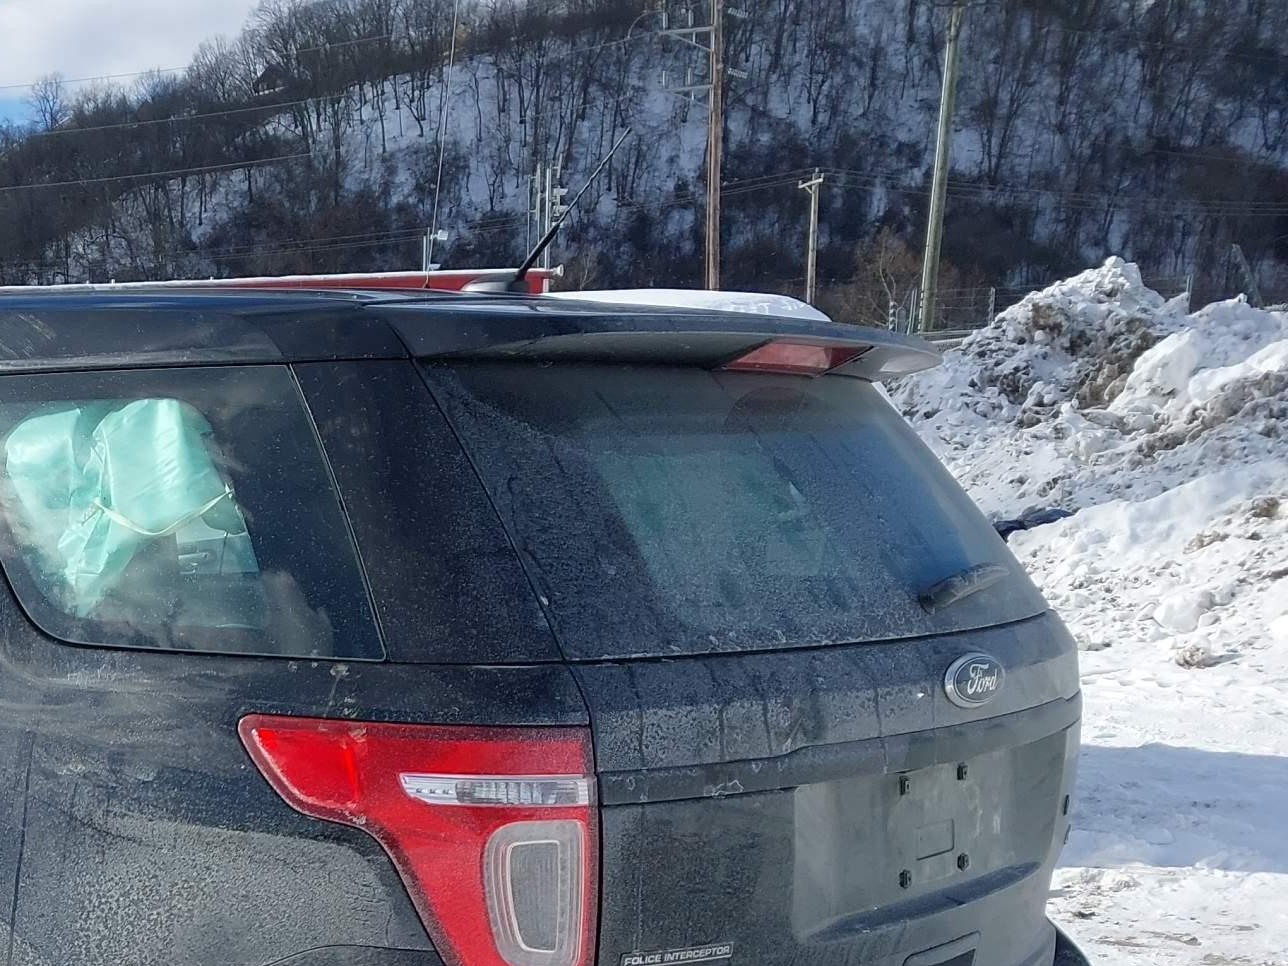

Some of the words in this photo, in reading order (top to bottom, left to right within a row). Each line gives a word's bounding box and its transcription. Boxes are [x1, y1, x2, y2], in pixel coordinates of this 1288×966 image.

[967, 663, 998, 695] Ford
[624, 953, 662, 966] POLICE
[663, 945, 731, 962] INTERCEPTOR
